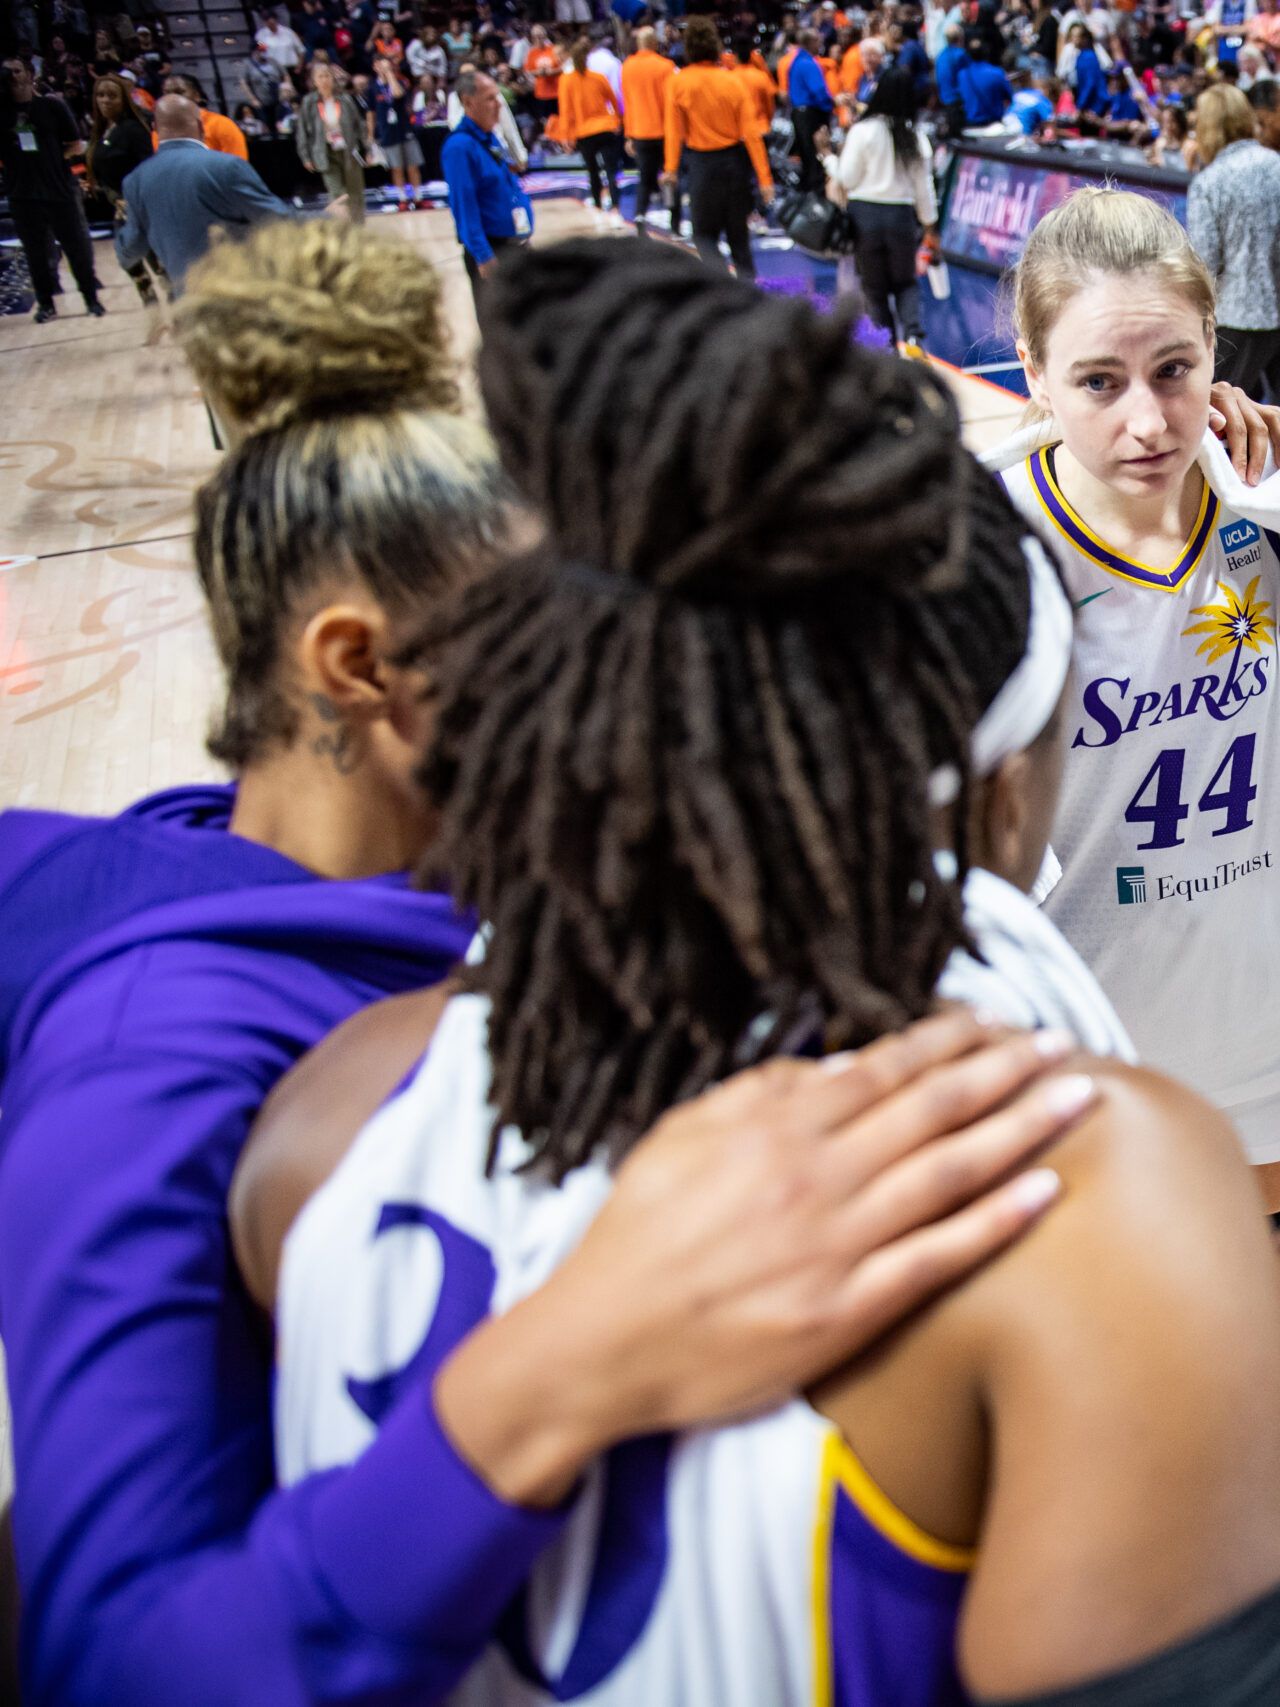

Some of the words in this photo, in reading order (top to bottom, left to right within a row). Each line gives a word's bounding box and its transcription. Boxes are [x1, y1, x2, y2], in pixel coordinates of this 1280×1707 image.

[1224, 524, 1256, 547] UCLA
[1124, 732, 1258, 851] 44
[1156, 850, 1274, 902] EquiTrust
